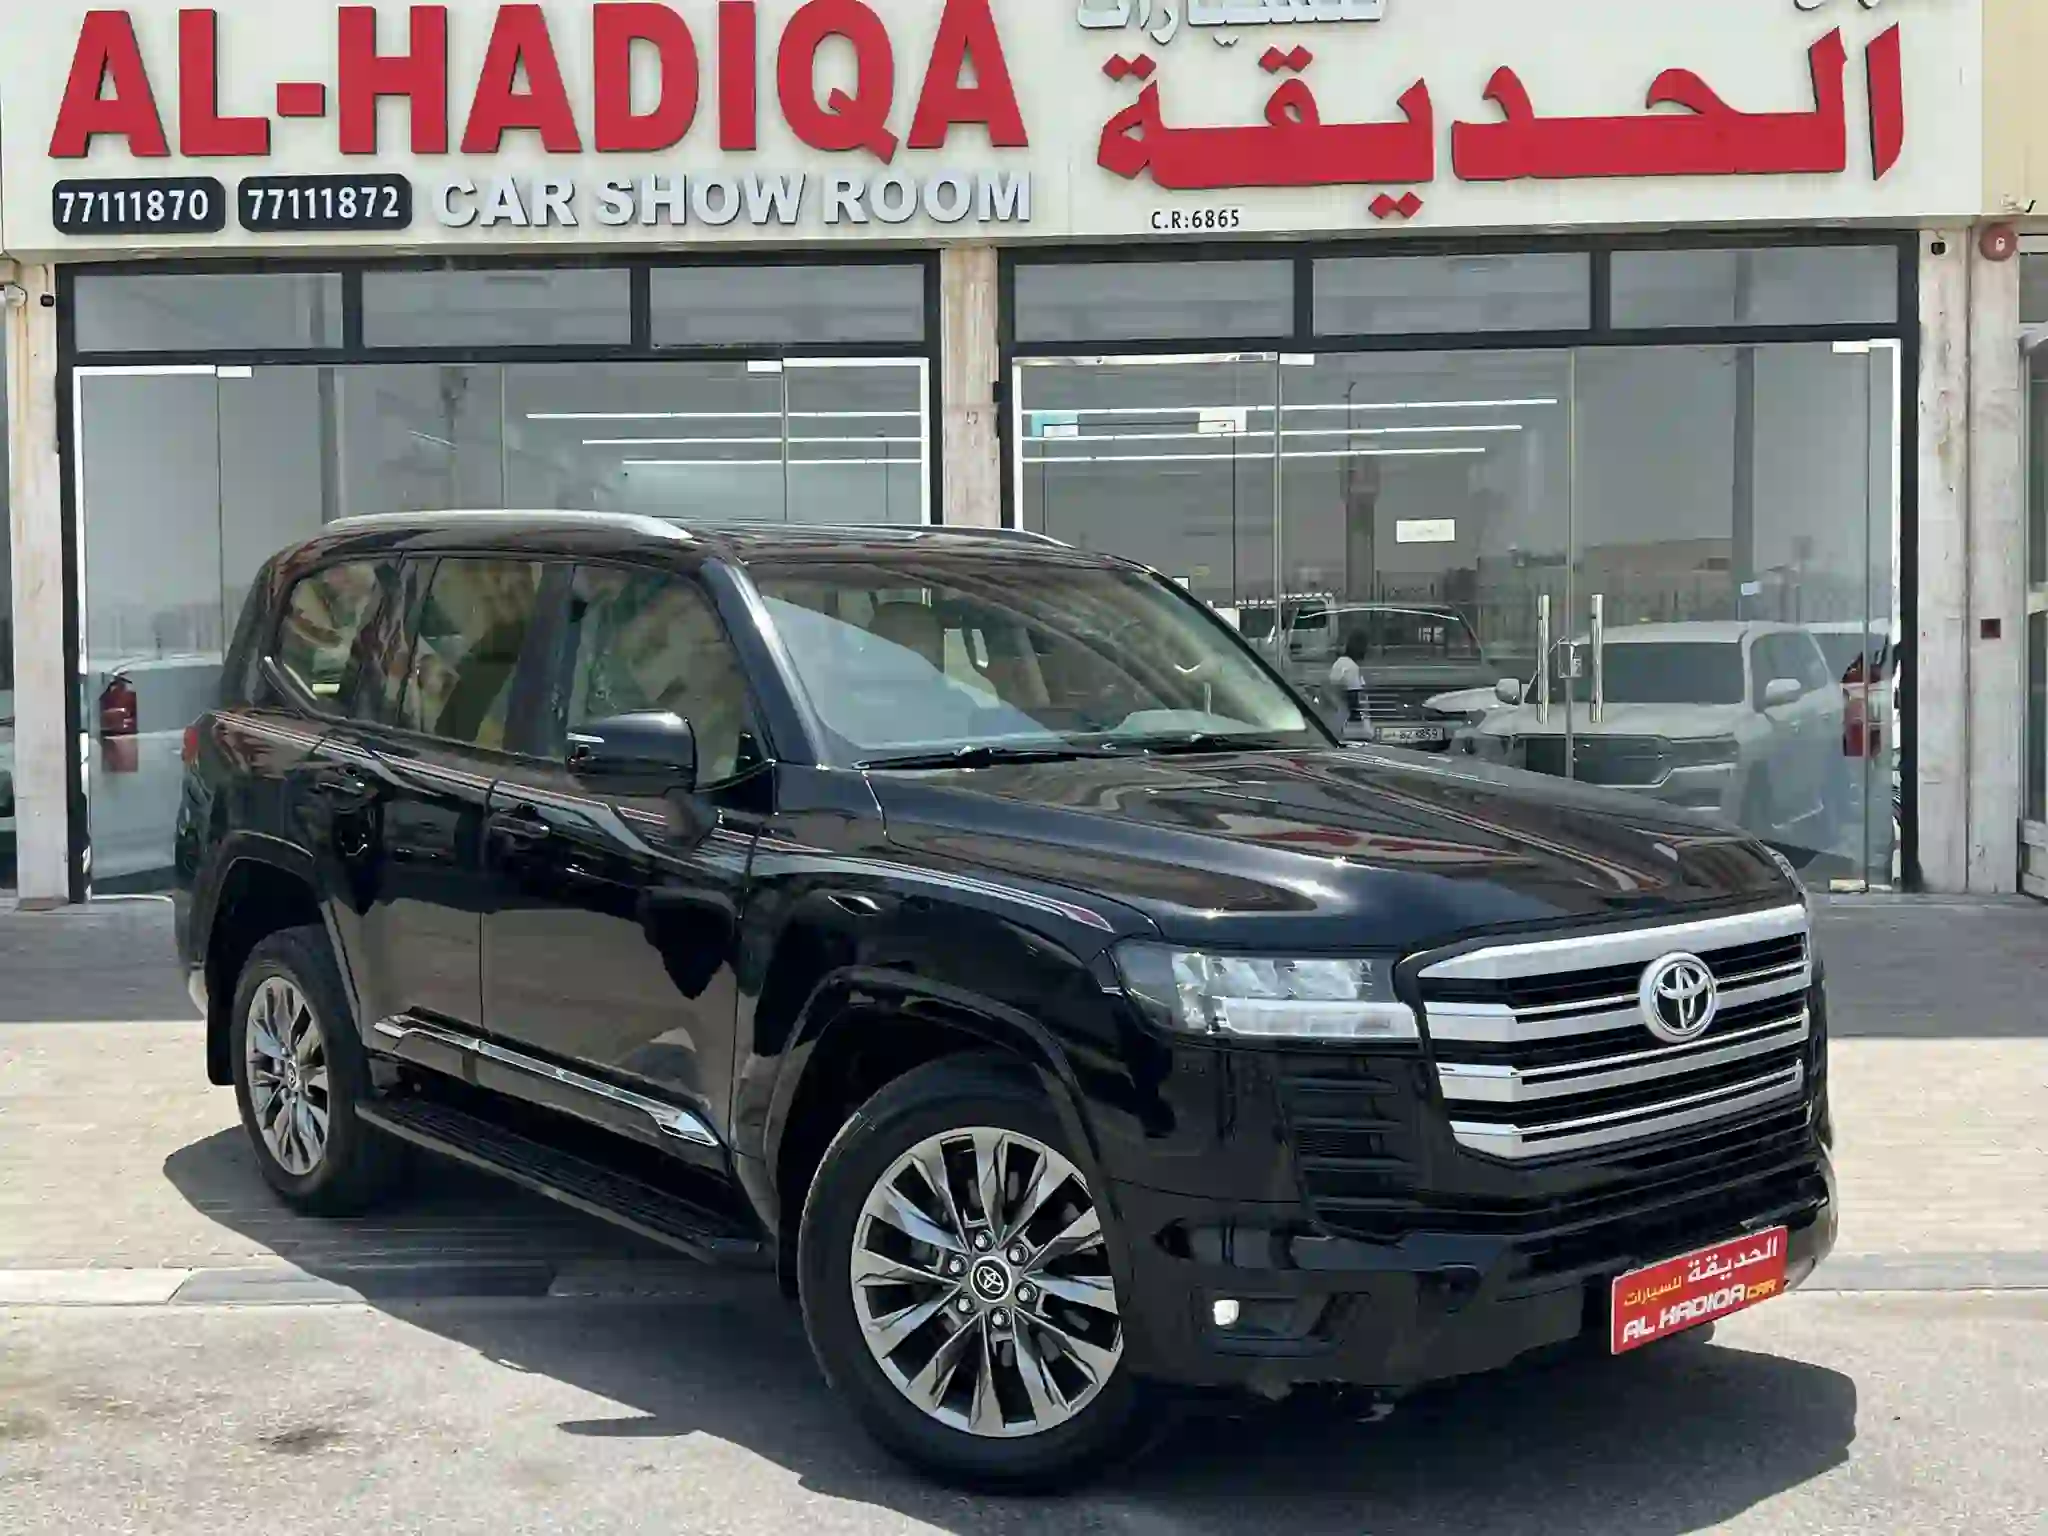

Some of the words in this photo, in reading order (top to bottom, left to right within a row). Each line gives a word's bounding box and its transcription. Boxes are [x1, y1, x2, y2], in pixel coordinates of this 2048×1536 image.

[48, 0, 1029, 165] AL-HADIQA
[1096, 22, 1905, 220] الحديقة
[57, 190, 210, 223] 77111870
[247, 186, 400, 219] 77111872
[431, 174, 577, 227] CAR
[596, 173, 807, 226] SHOW
[823, 171, 1032, 224] ROOM
[1150, 208, 1240, 229] C.R:6865
[1687, 1235, 1778, 1283] الحديقة
[1624, 1275, 1682, 1306] للسيارات
[1623, 1315, 1656, 1344] AL
